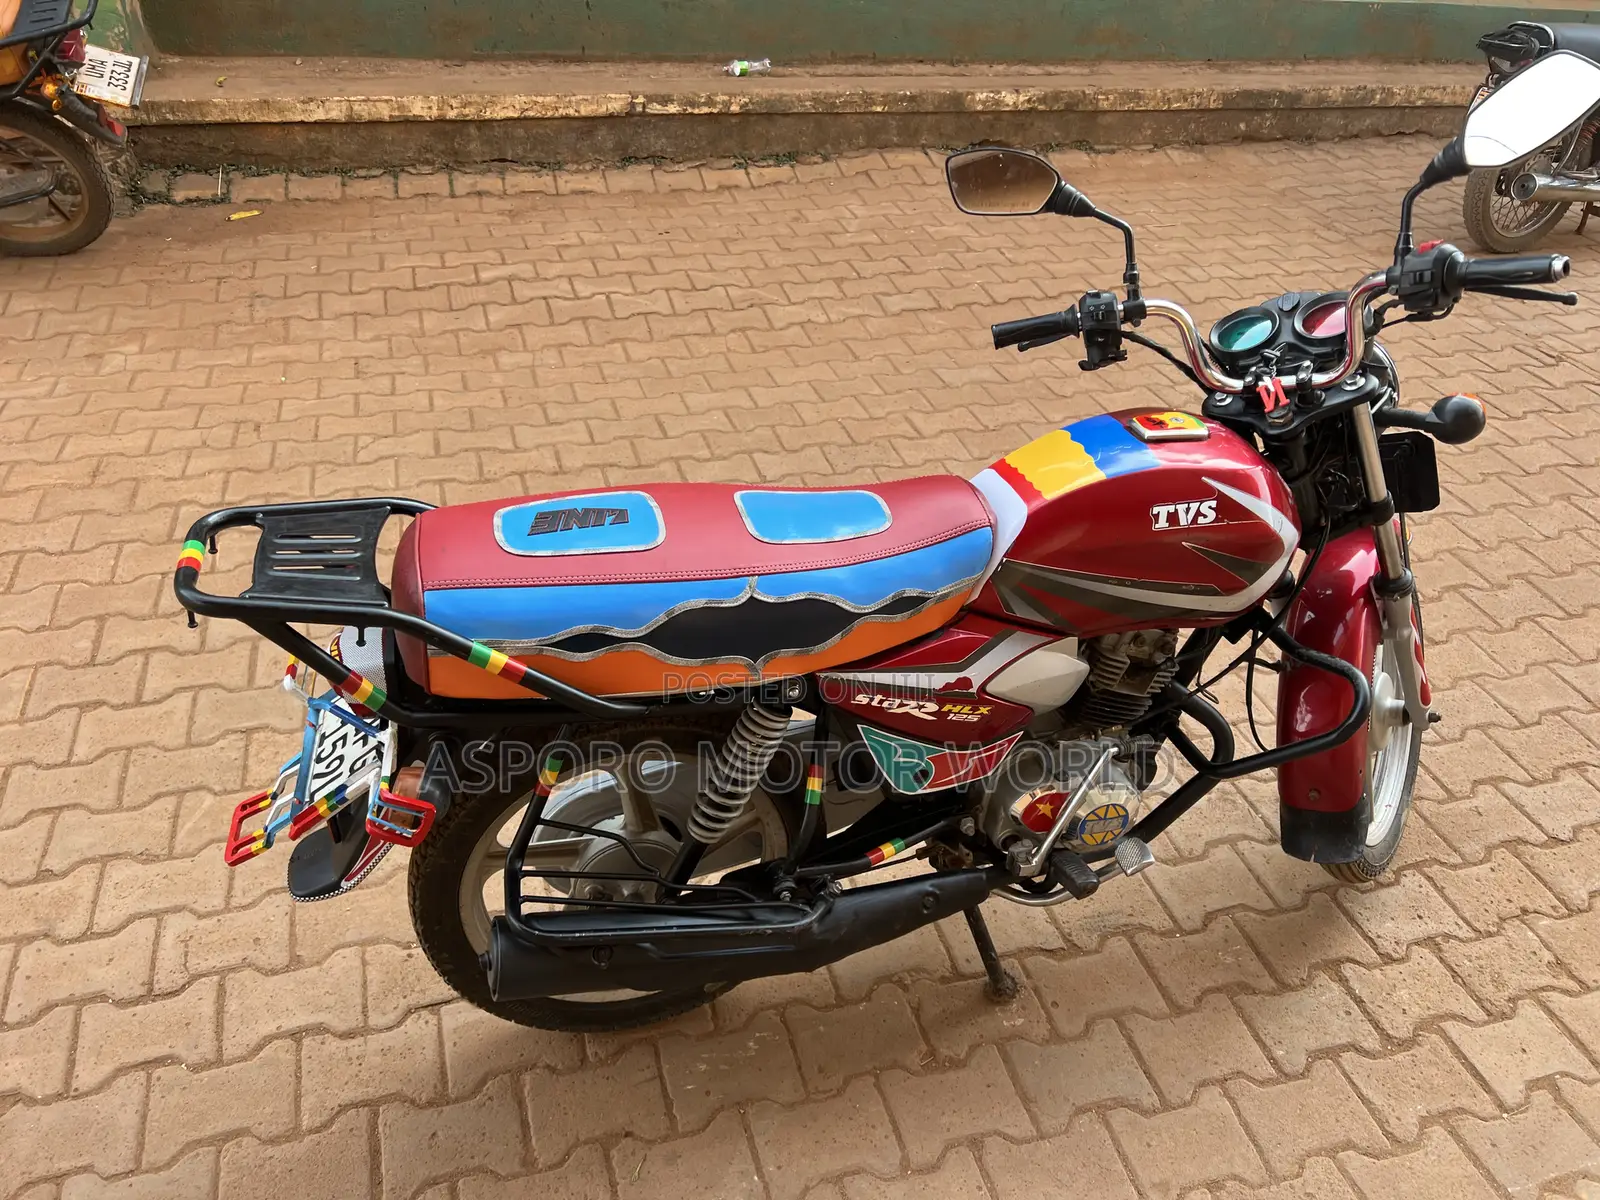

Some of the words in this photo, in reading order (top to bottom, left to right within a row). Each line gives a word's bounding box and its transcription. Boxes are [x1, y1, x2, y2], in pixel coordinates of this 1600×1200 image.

[1151, 500, 1218, 529] TVS
[940, 703, 993, 716] HLX
[946, 713, 982, 722] 125
